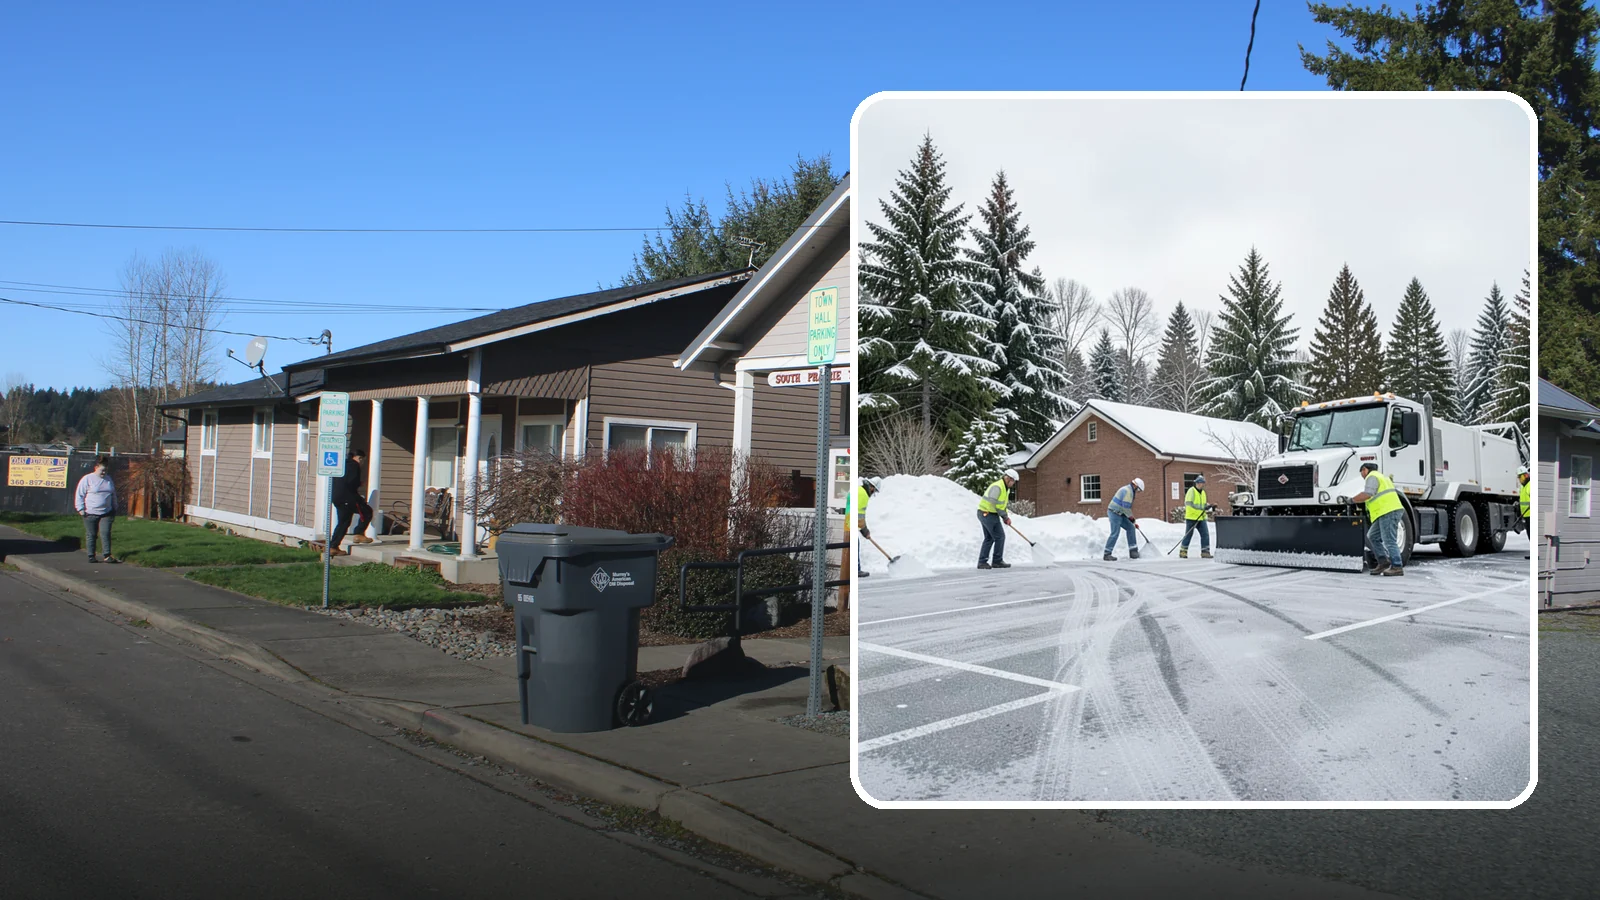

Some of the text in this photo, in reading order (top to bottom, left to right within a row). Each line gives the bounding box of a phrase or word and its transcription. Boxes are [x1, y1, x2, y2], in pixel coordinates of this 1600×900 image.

[815, 295, 832, 307] TOWN
[814, 311, 831, 325] HALL
[810, 326, 835, 340] PARKING
[813, 344, 831, 357] ONLY
[775, 373, 801, 384] SOUTH
[807, 371, 842, 382] PRIE
